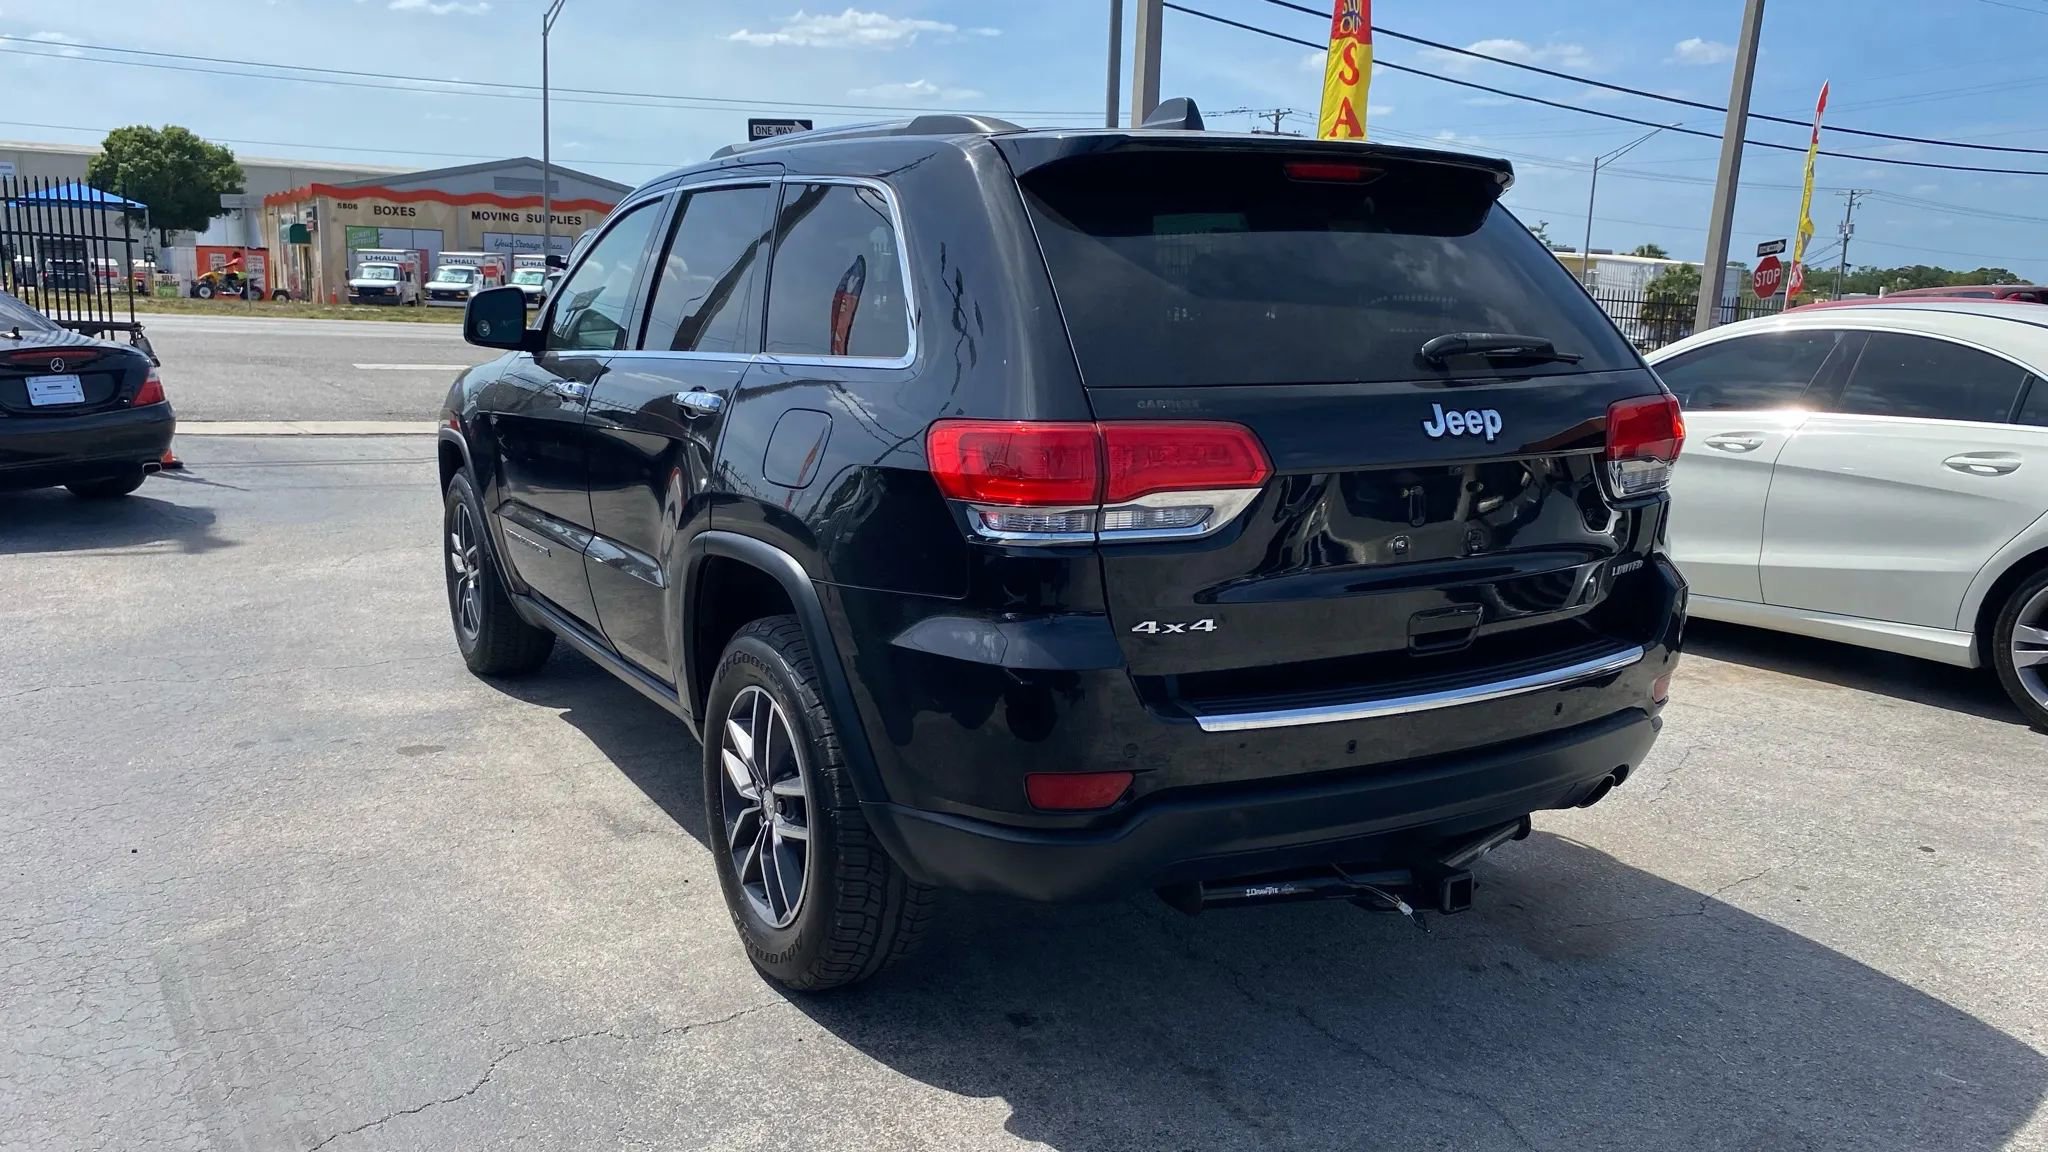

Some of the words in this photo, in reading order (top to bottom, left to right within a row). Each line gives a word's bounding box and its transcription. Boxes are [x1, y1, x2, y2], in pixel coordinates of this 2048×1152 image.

[755, 126, 772, 135] ONE
[775, 126, 793, 135] WAY
[373, 205, 416, 217] BOXES
[471, 211, 519, 222] MOVING
[1754, 268, 1780, 288] STOP
[1423, 402, 1502, 441] Jeep
[1131, 618, 1218, 635] 4x4
